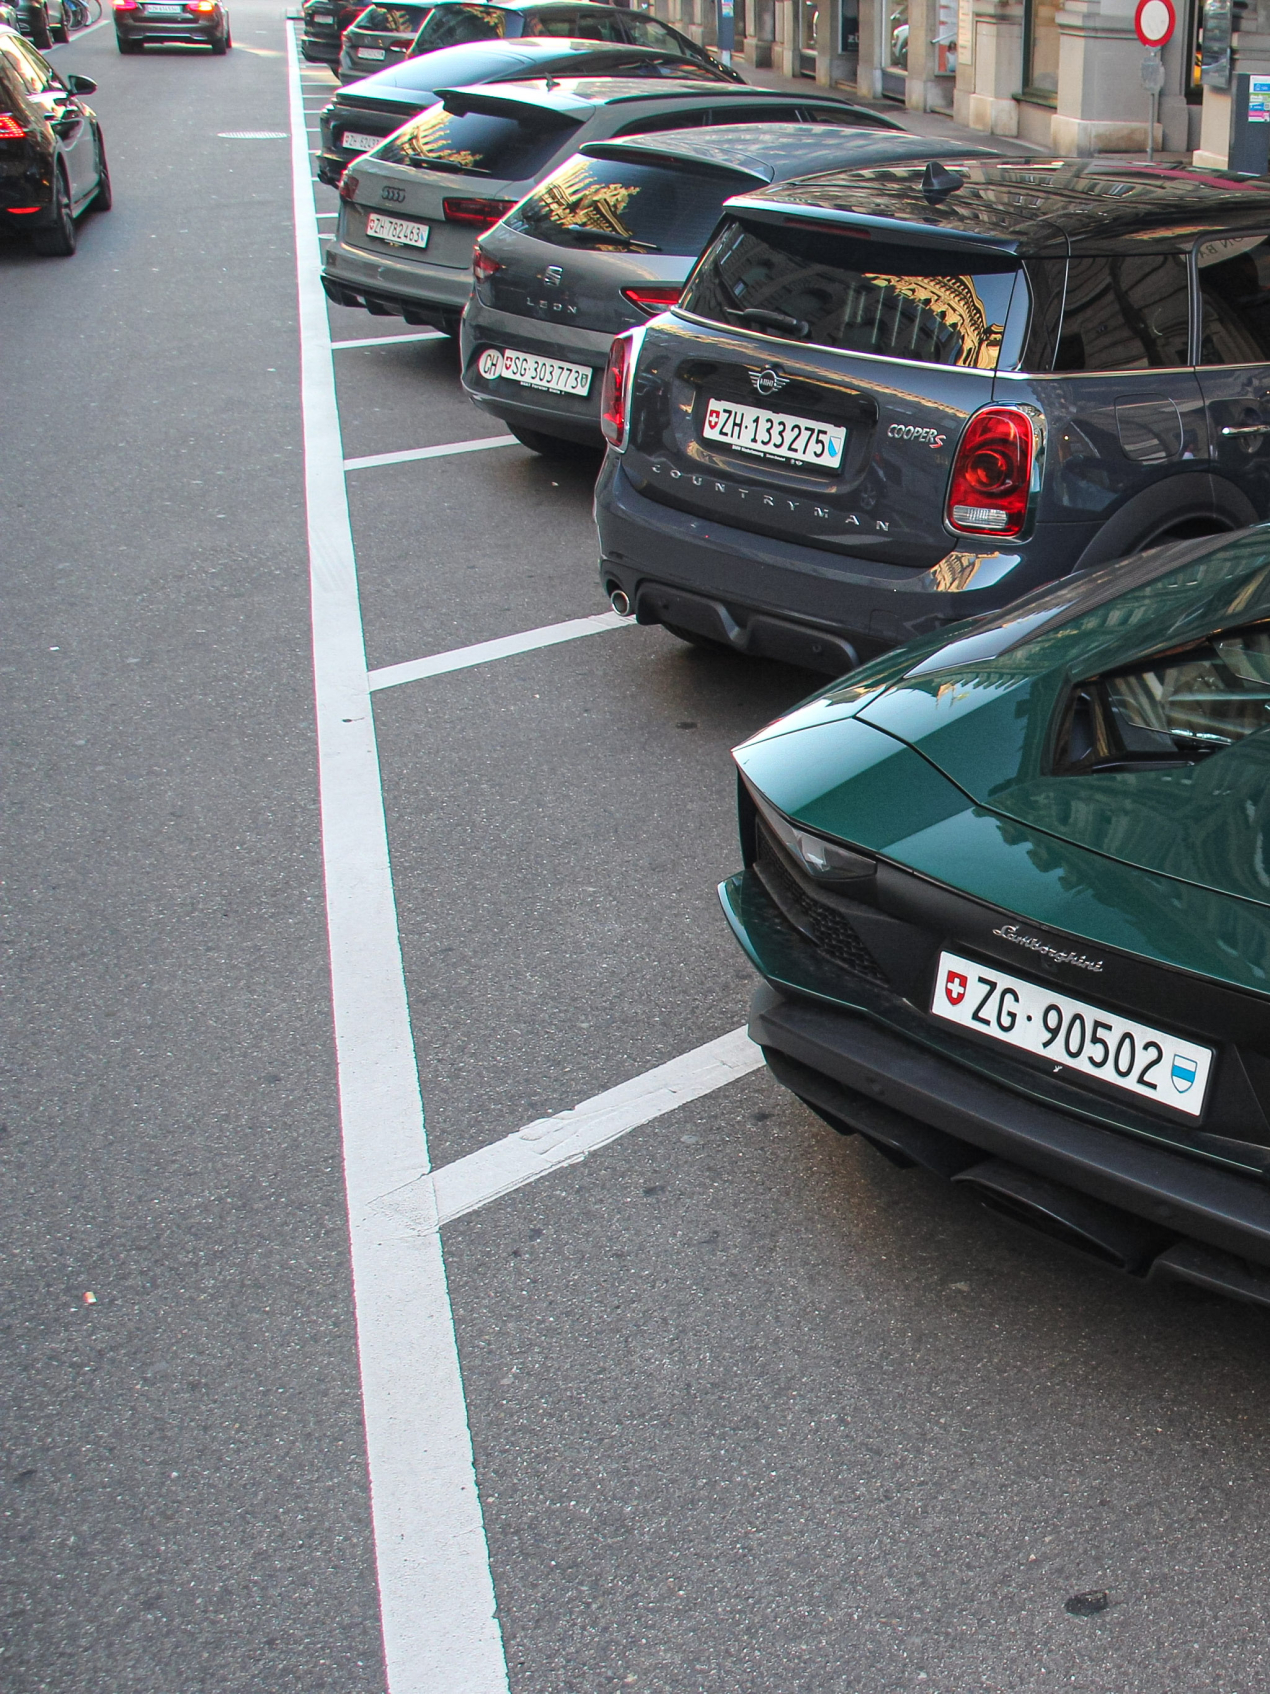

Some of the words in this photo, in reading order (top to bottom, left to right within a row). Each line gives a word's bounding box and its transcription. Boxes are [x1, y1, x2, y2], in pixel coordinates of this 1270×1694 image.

[526, 297, 577, 314] LEON
[483, 353, 499, 377] CH
[512, 356, 580, 389] SG·303773
[652, 463, 889, 532] COUNTRYMAN
[993, 925, 1103, 972] Lamborghini
[971, 976, 1163, 1090] ZG·90502
